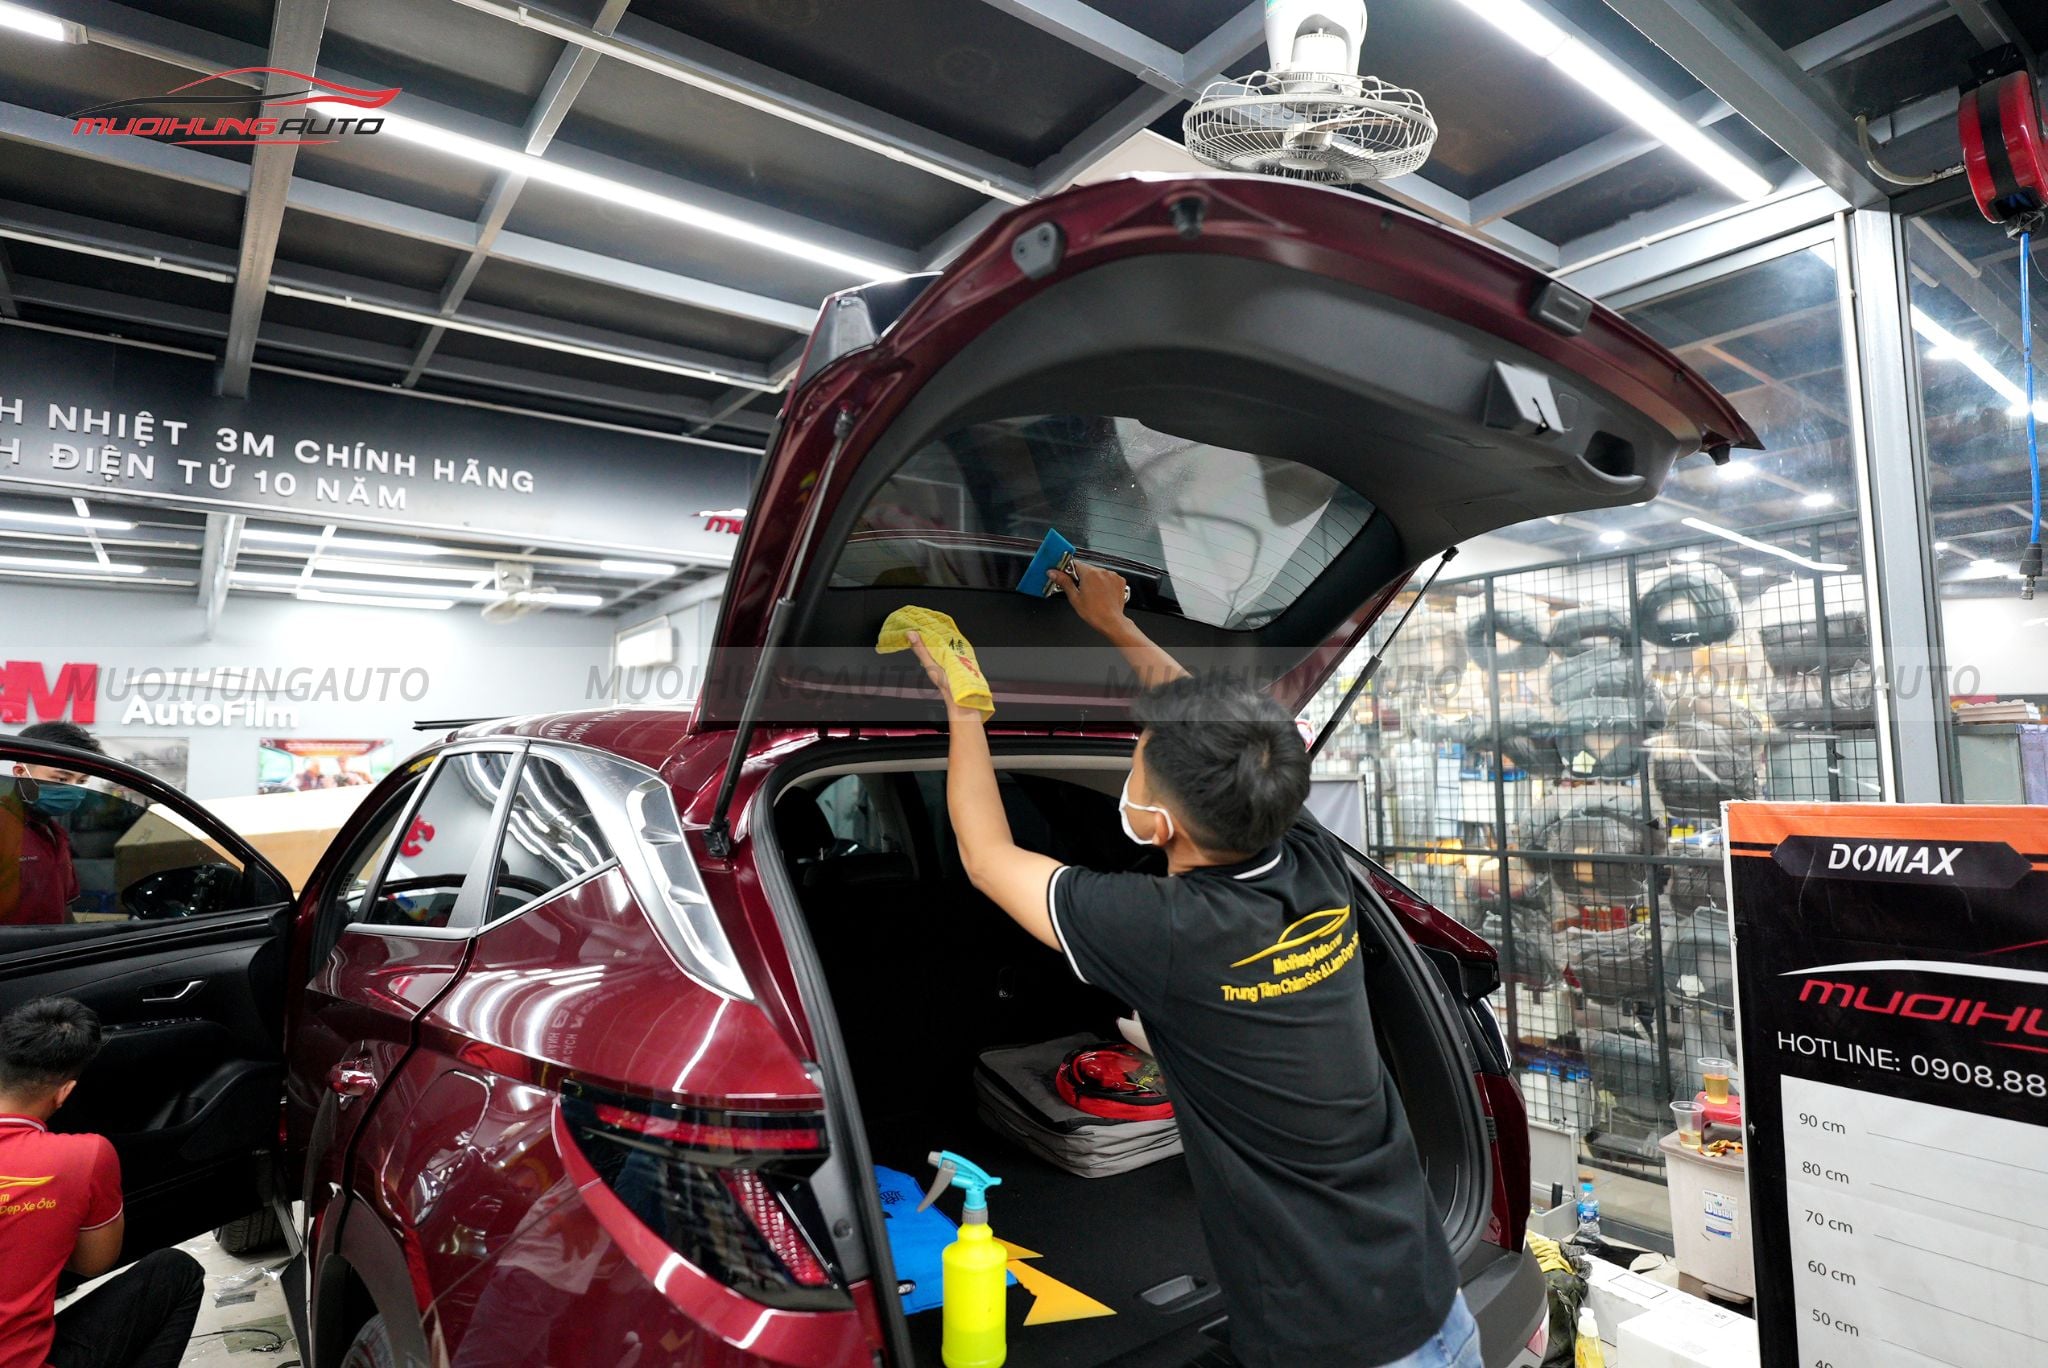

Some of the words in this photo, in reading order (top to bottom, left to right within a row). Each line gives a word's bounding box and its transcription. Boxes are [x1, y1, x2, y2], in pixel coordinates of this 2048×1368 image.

[48, 402, 188, 448] NHIỆT
[215, 427, 275, 458] 3M
[294, 439, 416, 478] CHÍNH
[433, 458, 535, 494] HÃNG
[49, 443, 155, 482] ĐIỆN
[177, 457, 236, 489] TỬ
[254, 469, 297, 497] 10
[316, 476, 407, 510] NĂM
[0, 660, 97, 725] M
[121, 694, 299, 729] AutoFilm
[1827, 843, 1964, 877] DOMAX
[1220, 984, 1259, 1003] Trung
[1777, 1030, 1901, 1072] HOTLINE:
[1910, 1054, 2048, 1098] 0908.88
[1799, 1112, 1818, 1128] 90
[1822, 1120, 1846, 1134] cm
[1802, 1161, 1821, 1177] 80
[1825, 1169, 1850, 1184] cm
[21, 1200, 36, 1212] Xe
[1805, 1209, 1824, 1225] 70
[1828, 1218, 1853, 1234] cm
[1808, 1260, 1827, 1276] 60
[1831, 1269, 1856, 1286] cm
[1812, 1308, 1831, 1326] 50
[1835, 1319, 1859, 1337] cm
